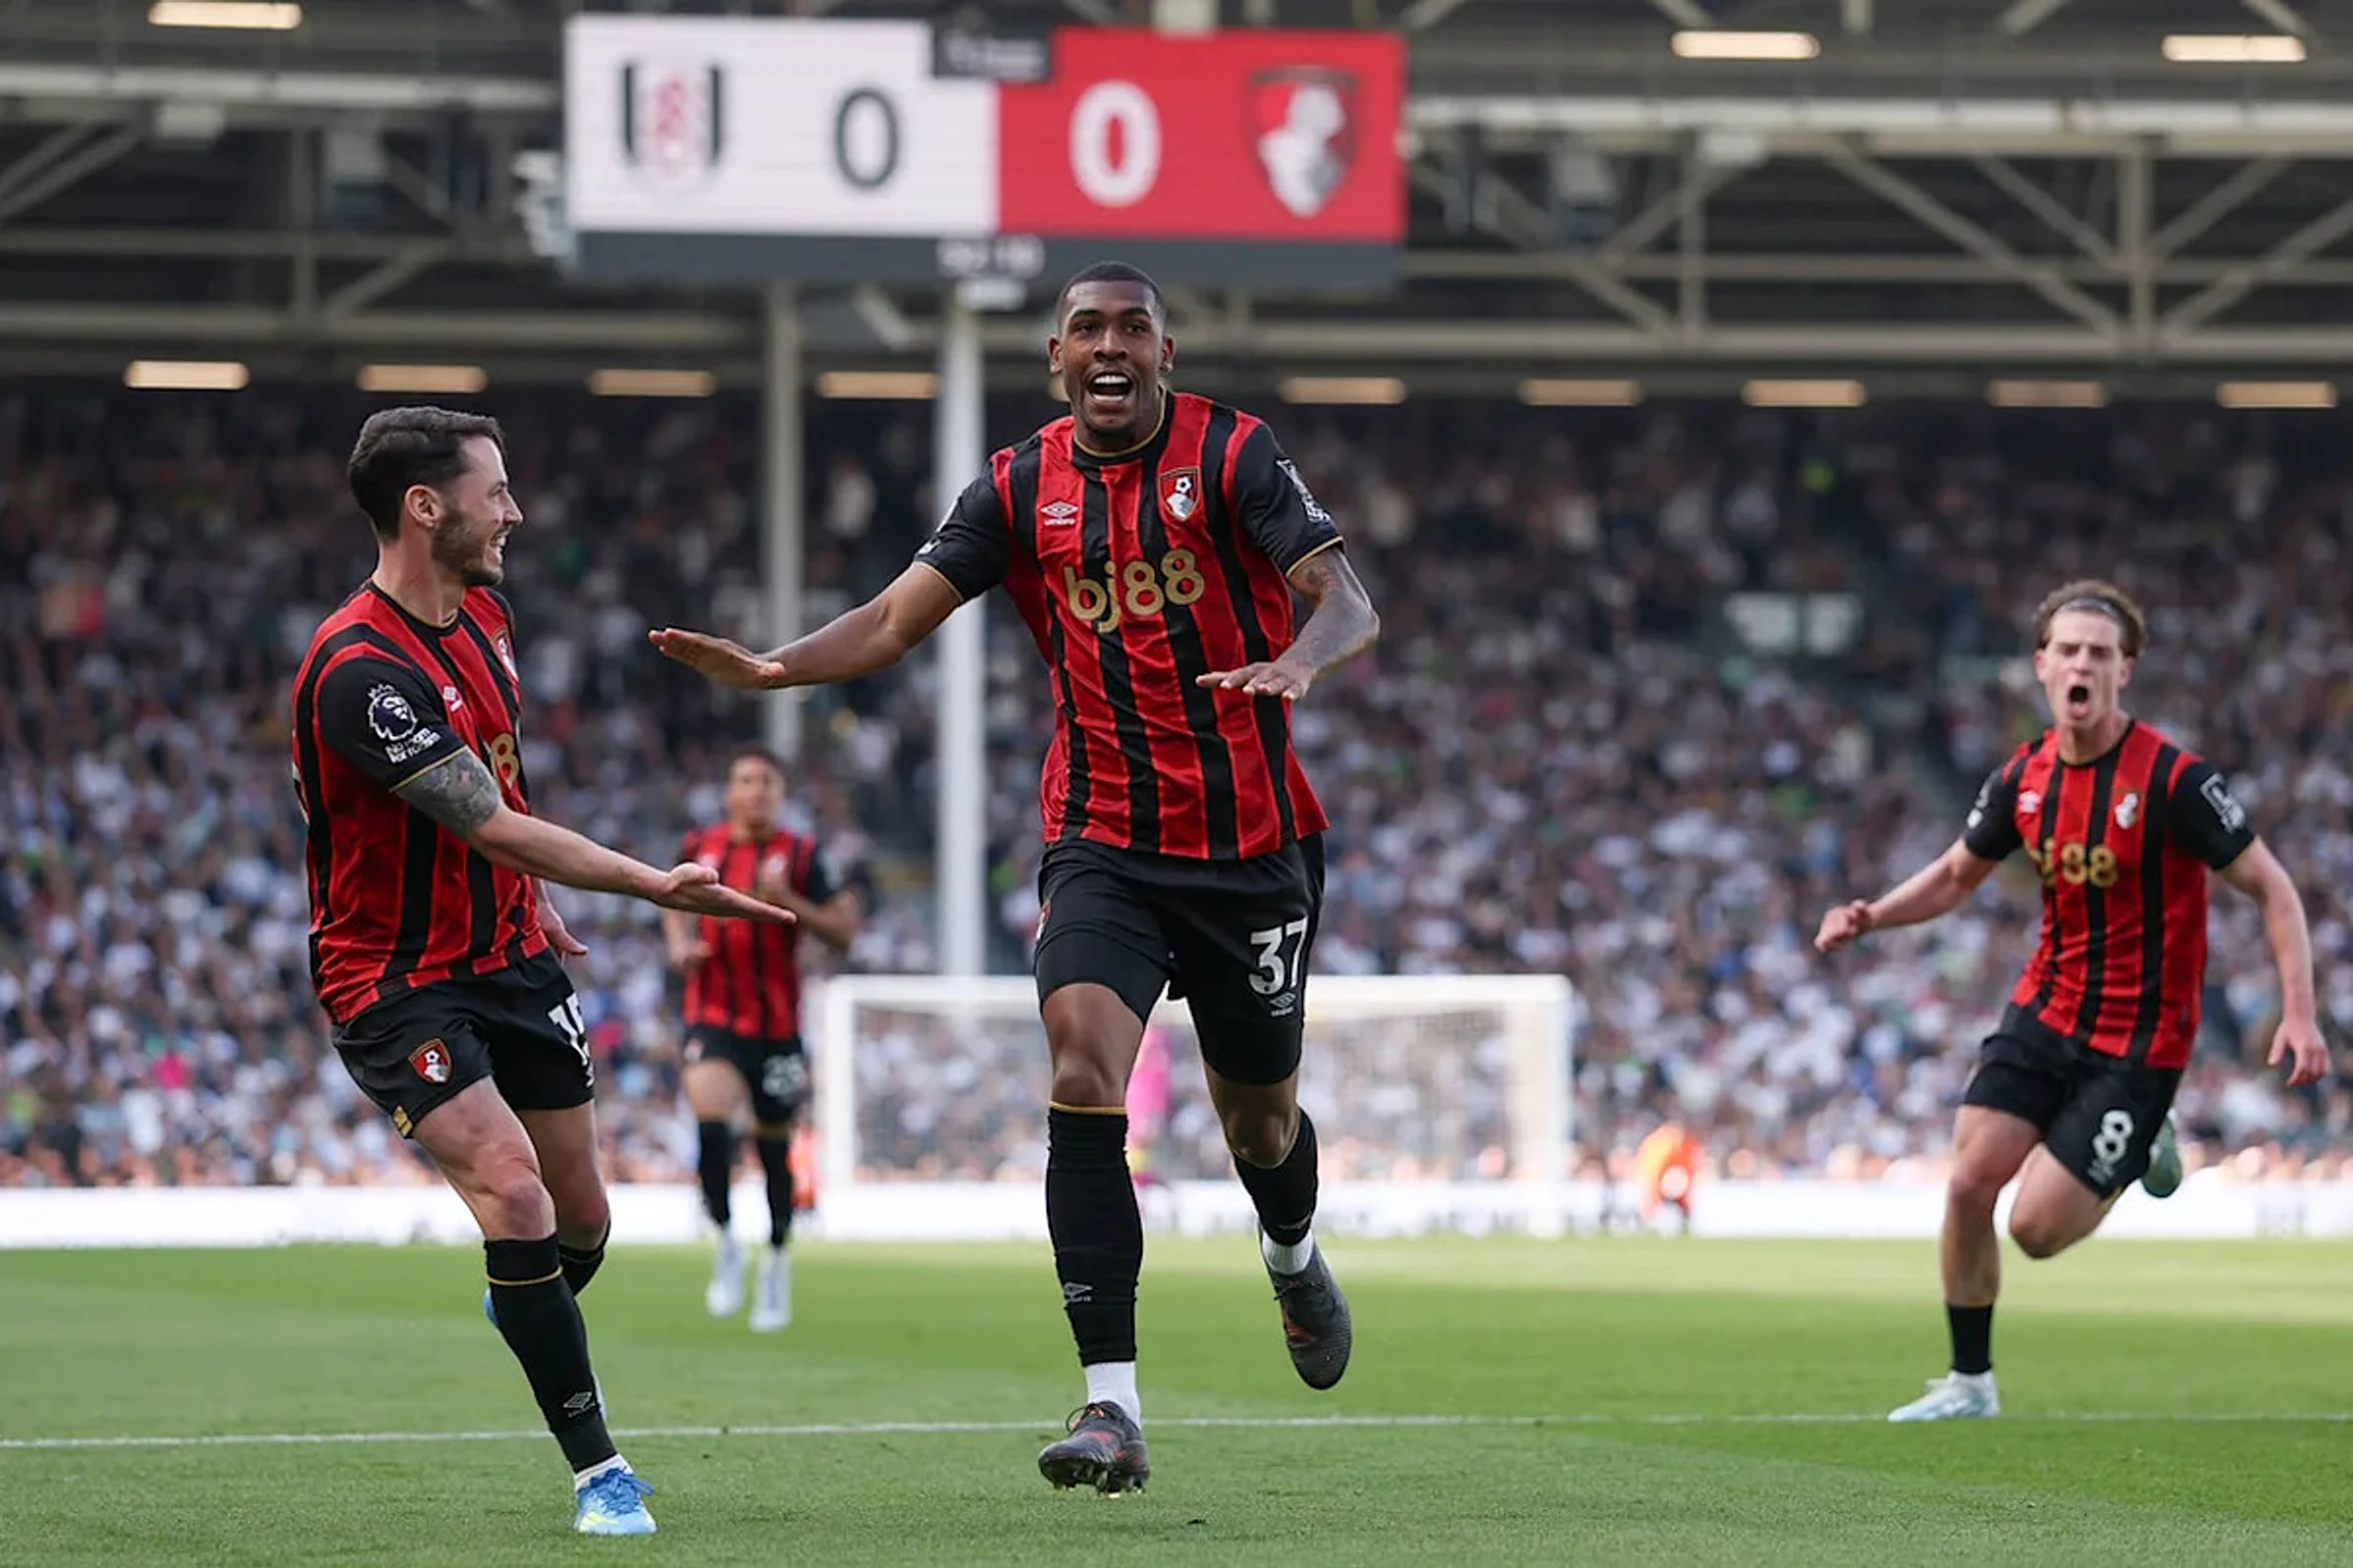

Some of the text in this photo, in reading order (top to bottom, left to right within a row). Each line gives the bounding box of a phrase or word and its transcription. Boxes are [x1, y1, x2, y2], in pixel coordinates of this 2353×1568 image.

[834, 78, 1163, 208] 0 0
[1064, 548, 1205, 634] bj88
[1248, 915, 1308, 994] 37
[2092, 1110, 2133, 1165] 8
